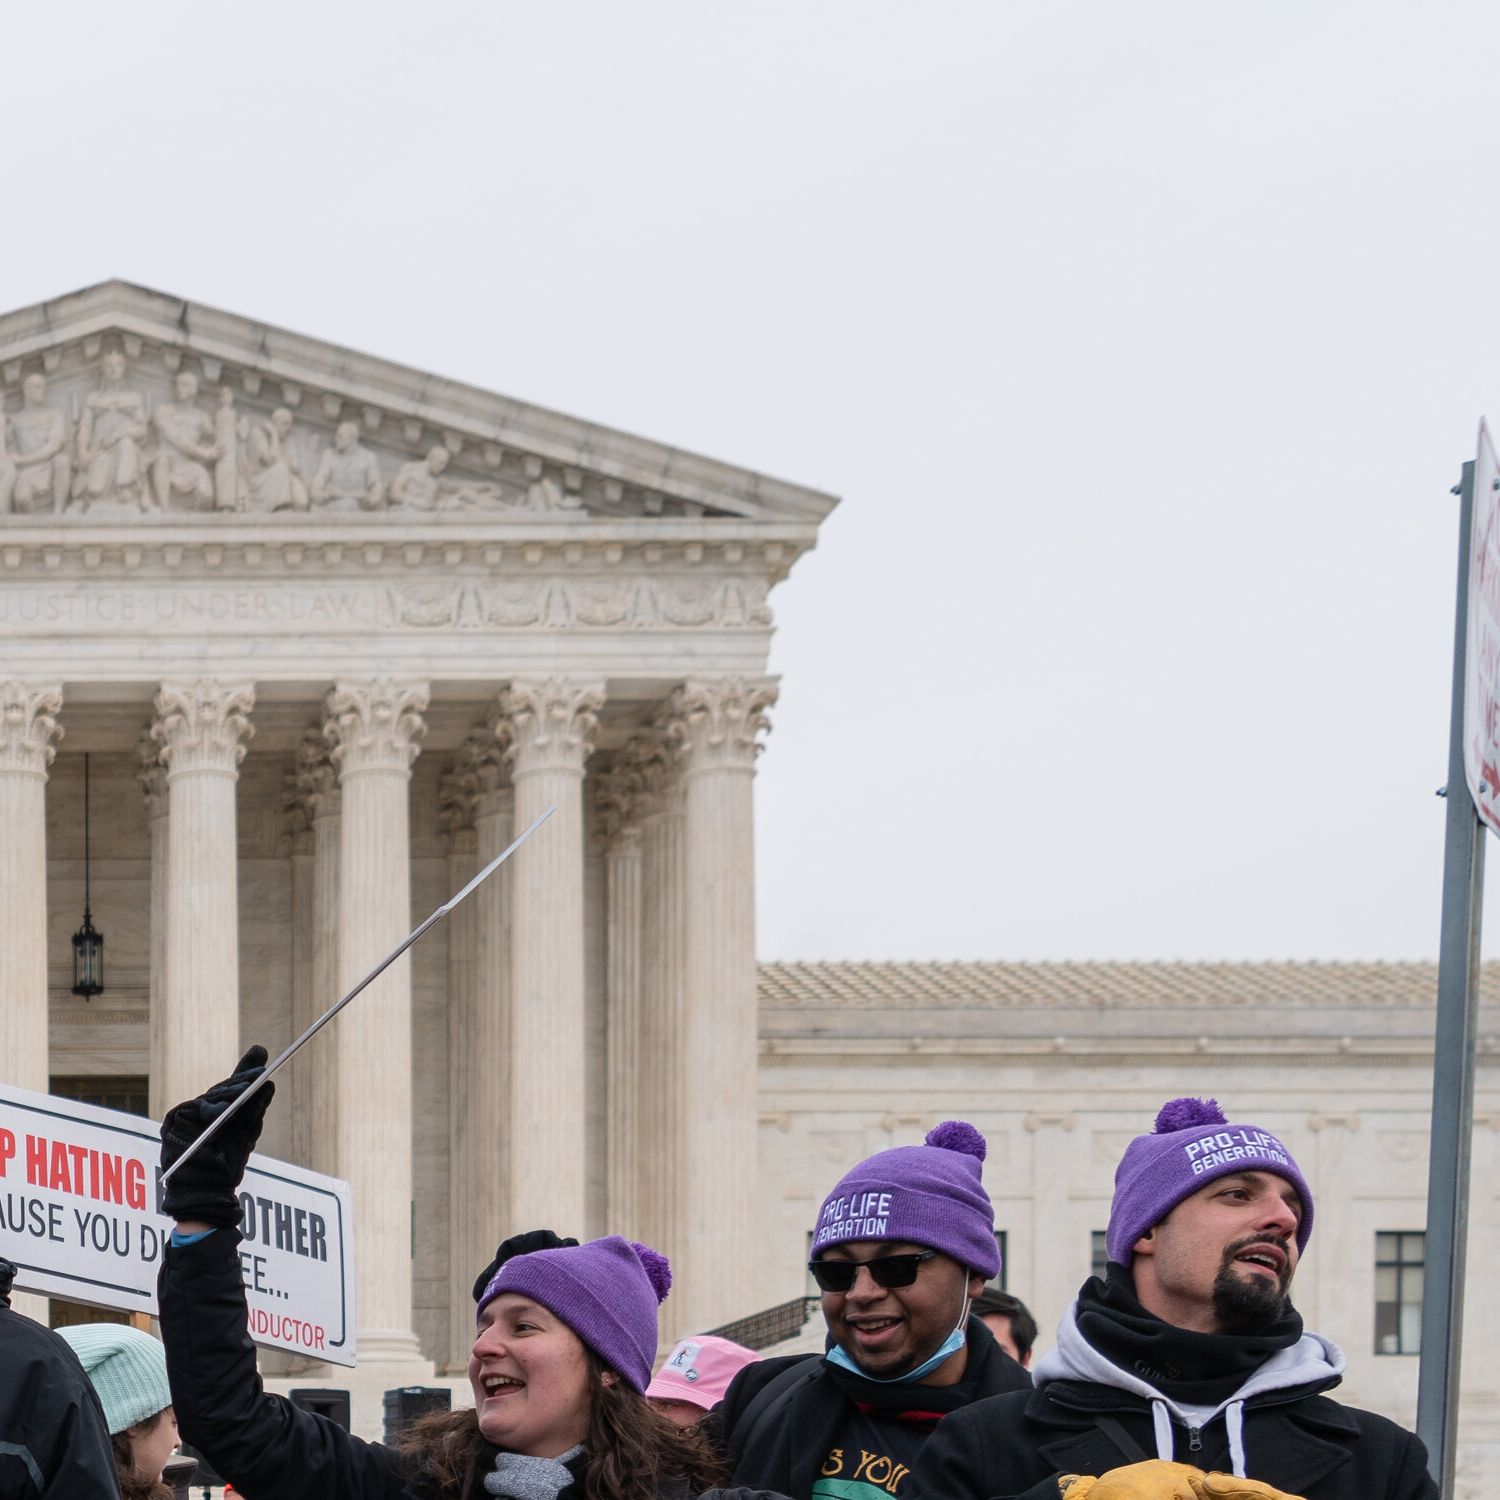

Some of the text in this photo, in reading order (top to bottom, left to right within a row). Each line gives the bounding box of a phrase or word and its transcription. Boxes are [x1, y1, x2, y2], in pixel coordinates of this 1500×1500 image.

[155, 594, 274, 622] UNDER
[290, 593, 357, 621] LAW
[1185, 1130, 1287, 1161] PRO-LIFE
[1191, 1145, 1289, 1175] GENERATION
[26, 1134, 146, 1211] HATING
[239, 1191, 328, 1262] OTHER
[822, 1193, 892, 1226] PRO-LIFE
[73, 1208, 130, 1257] YOU
[816, 1217, 887, 1245] GENERATION
[248, 1307, 325, 1351] NDUCTOR
[853, 1449, 910, 1493] YOU
